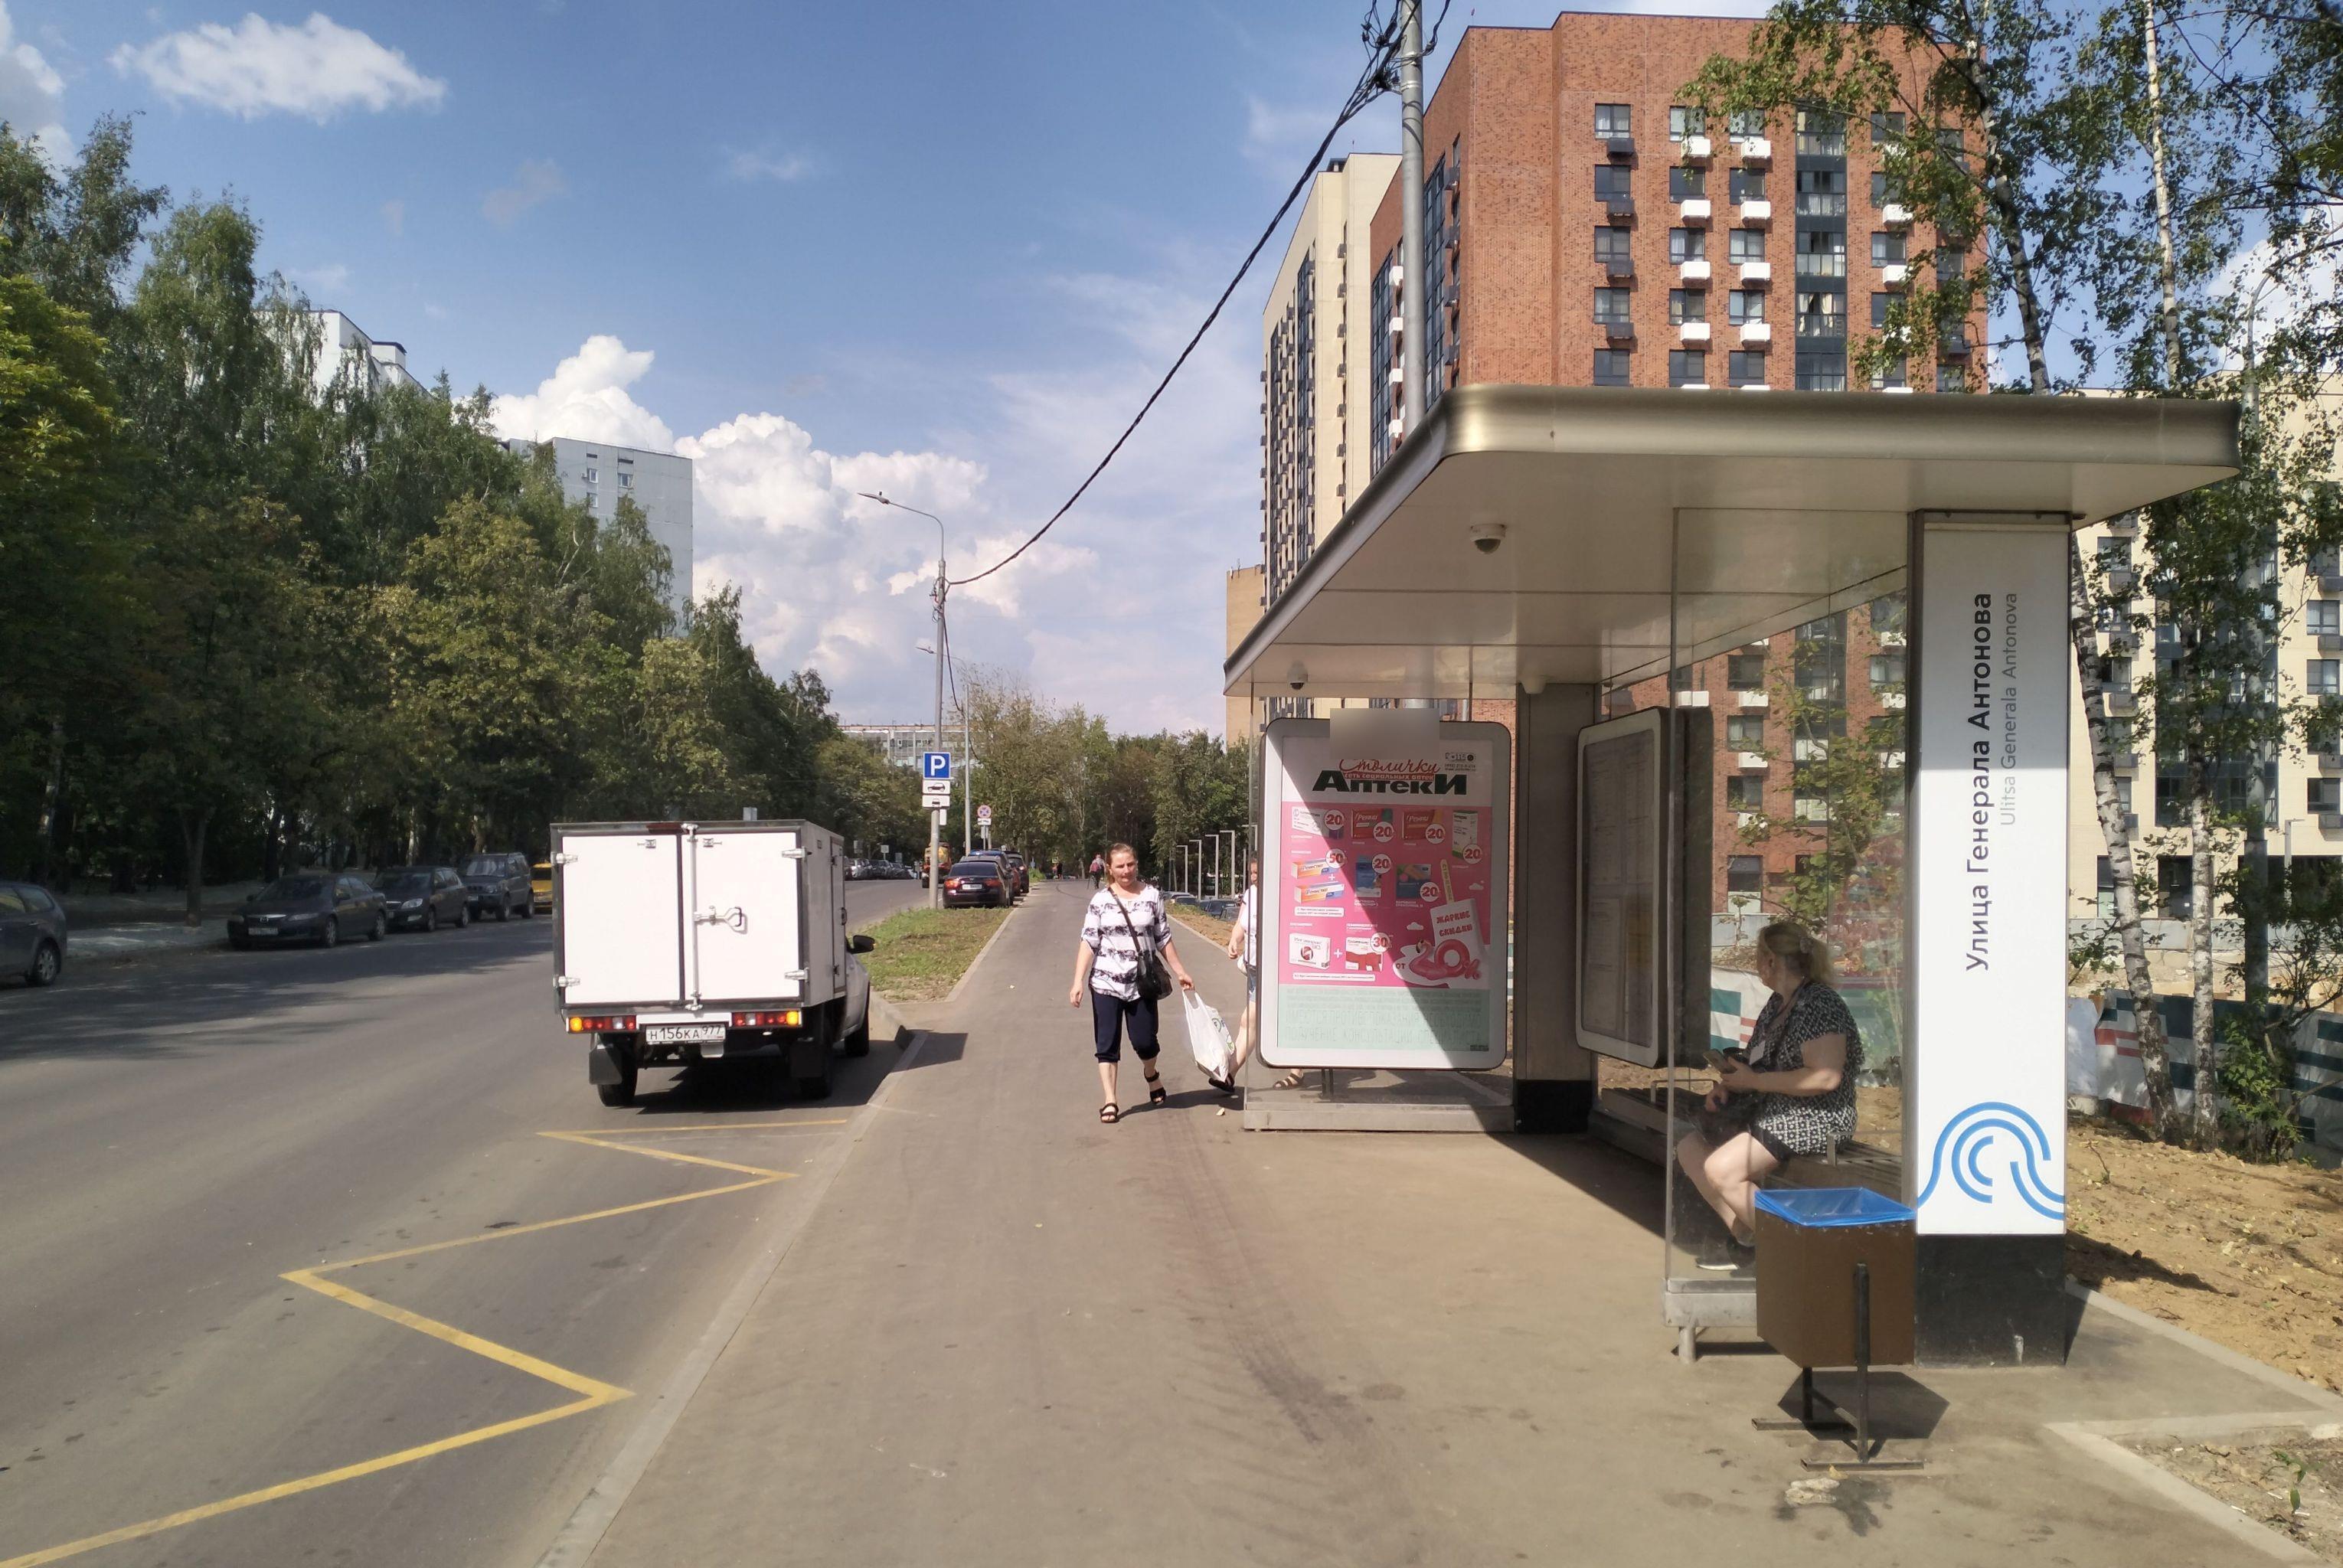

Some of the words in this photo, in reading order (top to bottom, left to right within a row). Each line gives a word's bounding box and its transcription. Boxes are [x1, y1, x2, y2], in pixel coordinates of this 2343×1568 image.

[1967, 593, 1992, 730] Антонова
[2002, 593, 2018, 678] Antonova
[931, 756, 946, 776] P
[2000, 687, 2018, 769] Generala
[1966, 741, 1995, 873] Генерала
[2000, 776, 2017, 826] Ulitsa
[1439, 924, 1472, 937] СКИДКИ
[1966, 885, 1992, 971] Улица
